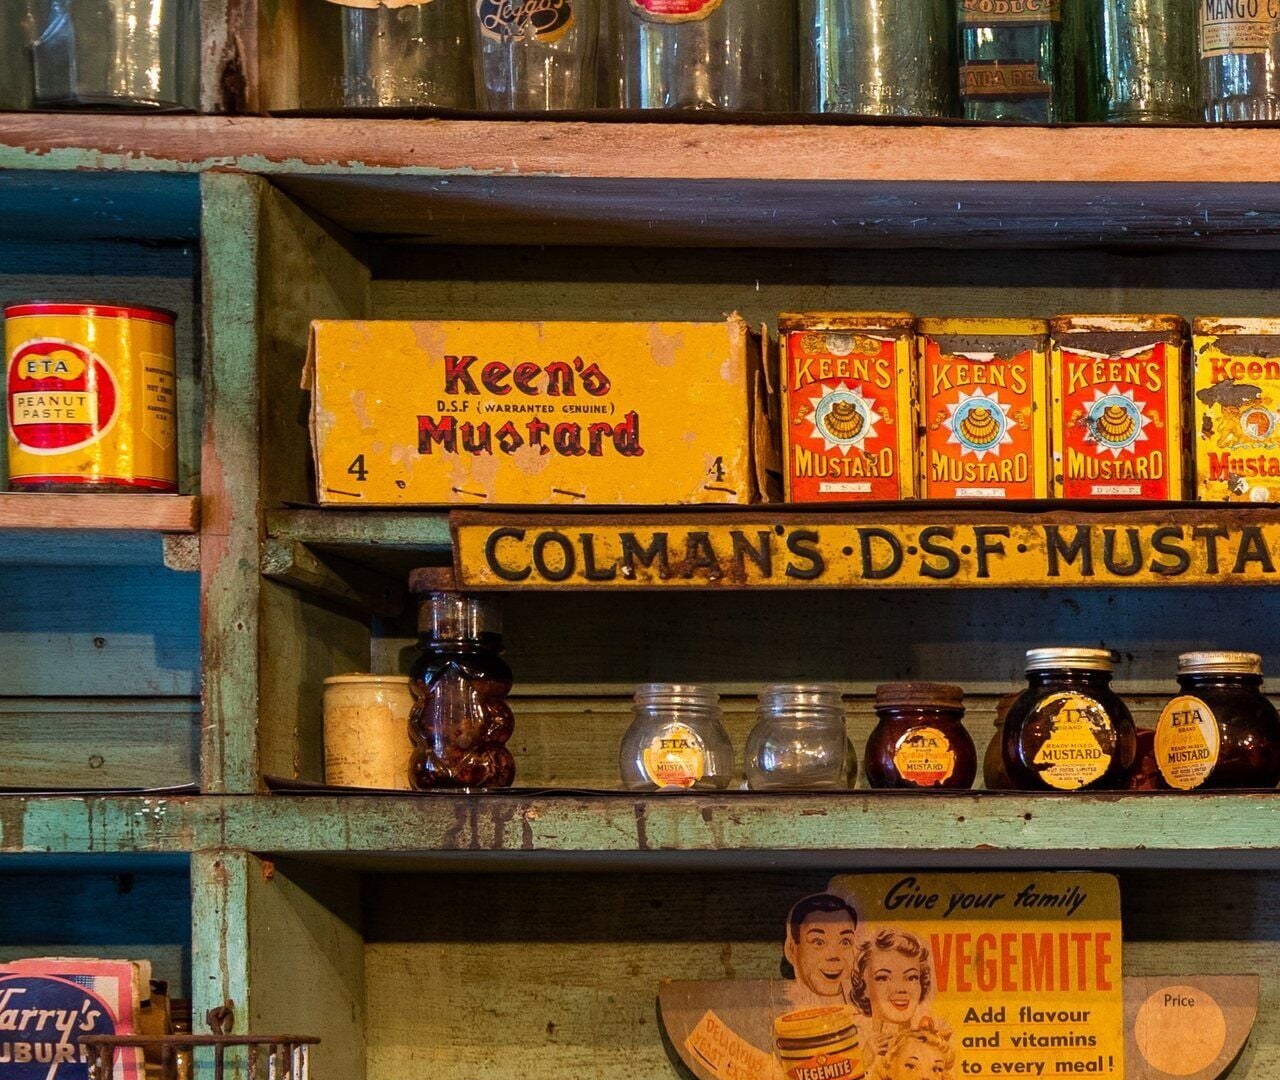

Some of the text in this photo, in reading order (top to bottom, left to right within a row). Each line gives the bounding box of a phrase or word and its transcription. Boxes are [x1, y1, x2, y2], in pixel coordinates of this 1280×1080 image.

[1206, 0, 1258, 19] MANGO
[27, 361, 68, 372] ETA
[443, 354, 612, 397] Keen's
[793, 358, 892, 392] KEEN'S
[932, 362, 1028, 398] KEEN'S
[18, 396, 86, 407] PEANUT
[23, 409, 75, 418] PASTE
[417, 411, 645, 457] Mustard
[347, 454, 368, 481] 4
[794, 444, 894, 478] MUSTARD
[932, 449, 1029, 484] MUSTARD
[484, 524, 825, 584] COLMAN'S
[1171, 709, 1203, 726] ETA
[1042, 749, 1102, 760] MUSTARD
[1168, 749, 1210, 763] MUSTARD
[884, 878, 1087, 918] Give your family
[930, 931, 1114, 994] VEGEMITE
[1163, 992, 1196, 1009] Price
[962, 1006, 1092, 1024] Add flavour
[961, 1030, 1098, 1048] and vitamins
[960, 1057, 984, 1074] to
[989, 1058, 1048, 1077] every
